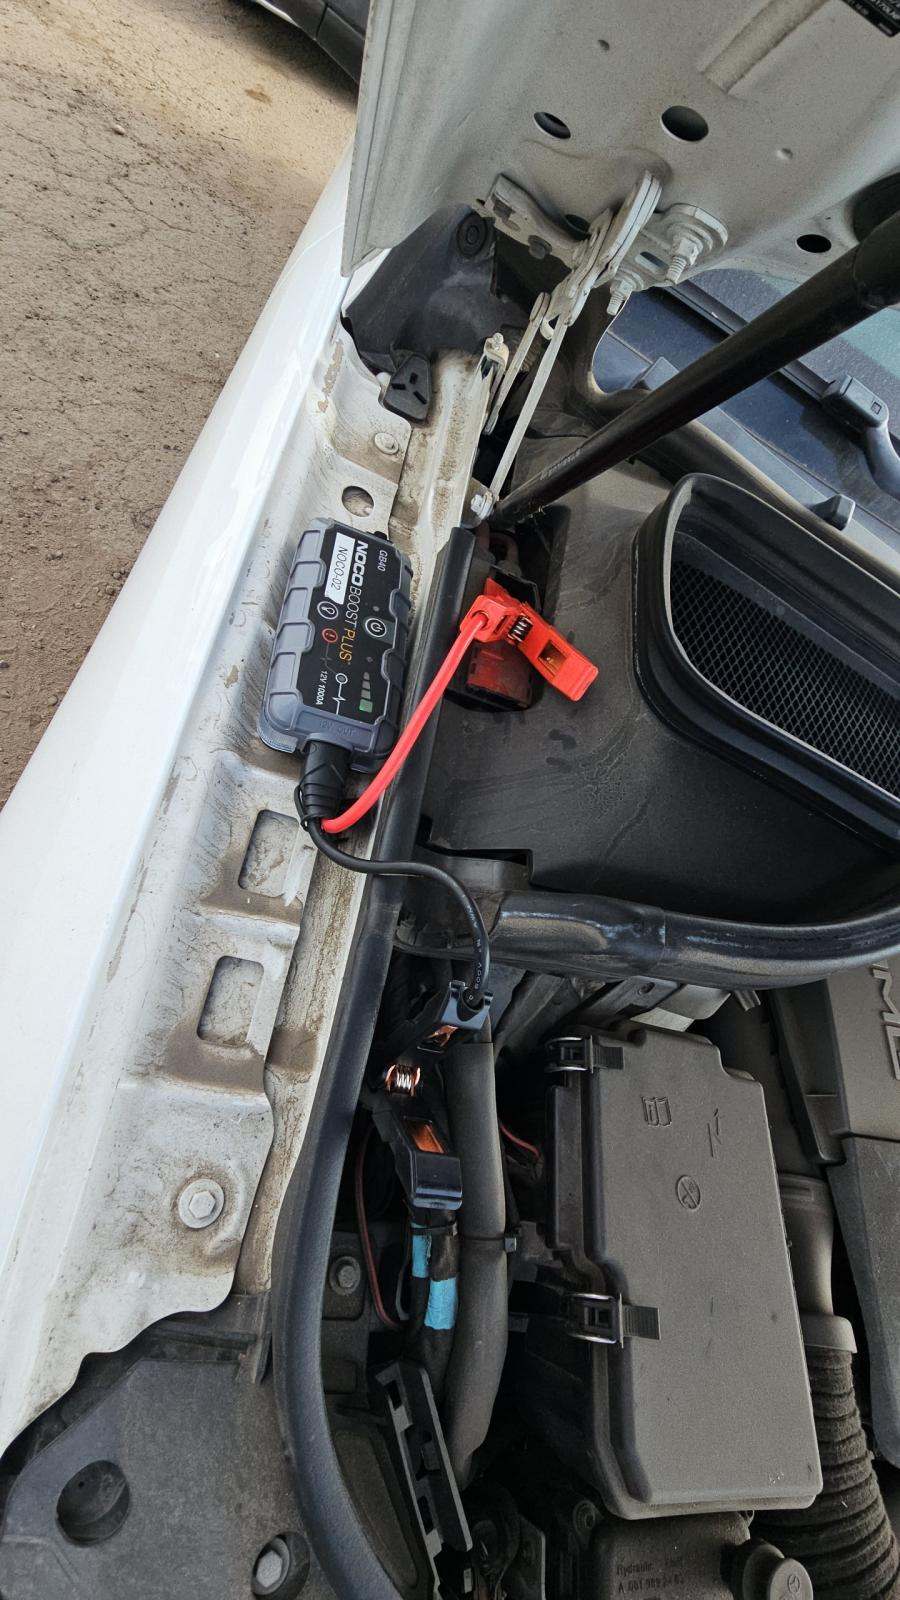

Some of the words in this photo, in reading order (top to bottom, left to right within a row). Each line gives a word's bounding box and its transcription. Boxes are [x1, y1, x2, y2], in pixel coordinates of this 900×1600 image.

[330, 547, 348, 591] NOCO-02
[351, 540, 369, 586] NOCO
[377, 550, 388, 572] GB40
[344, 586, 362, 628] BOOST
[320, 670, 328, 685] 12V
[315, 685, 326, 705] 1000A
